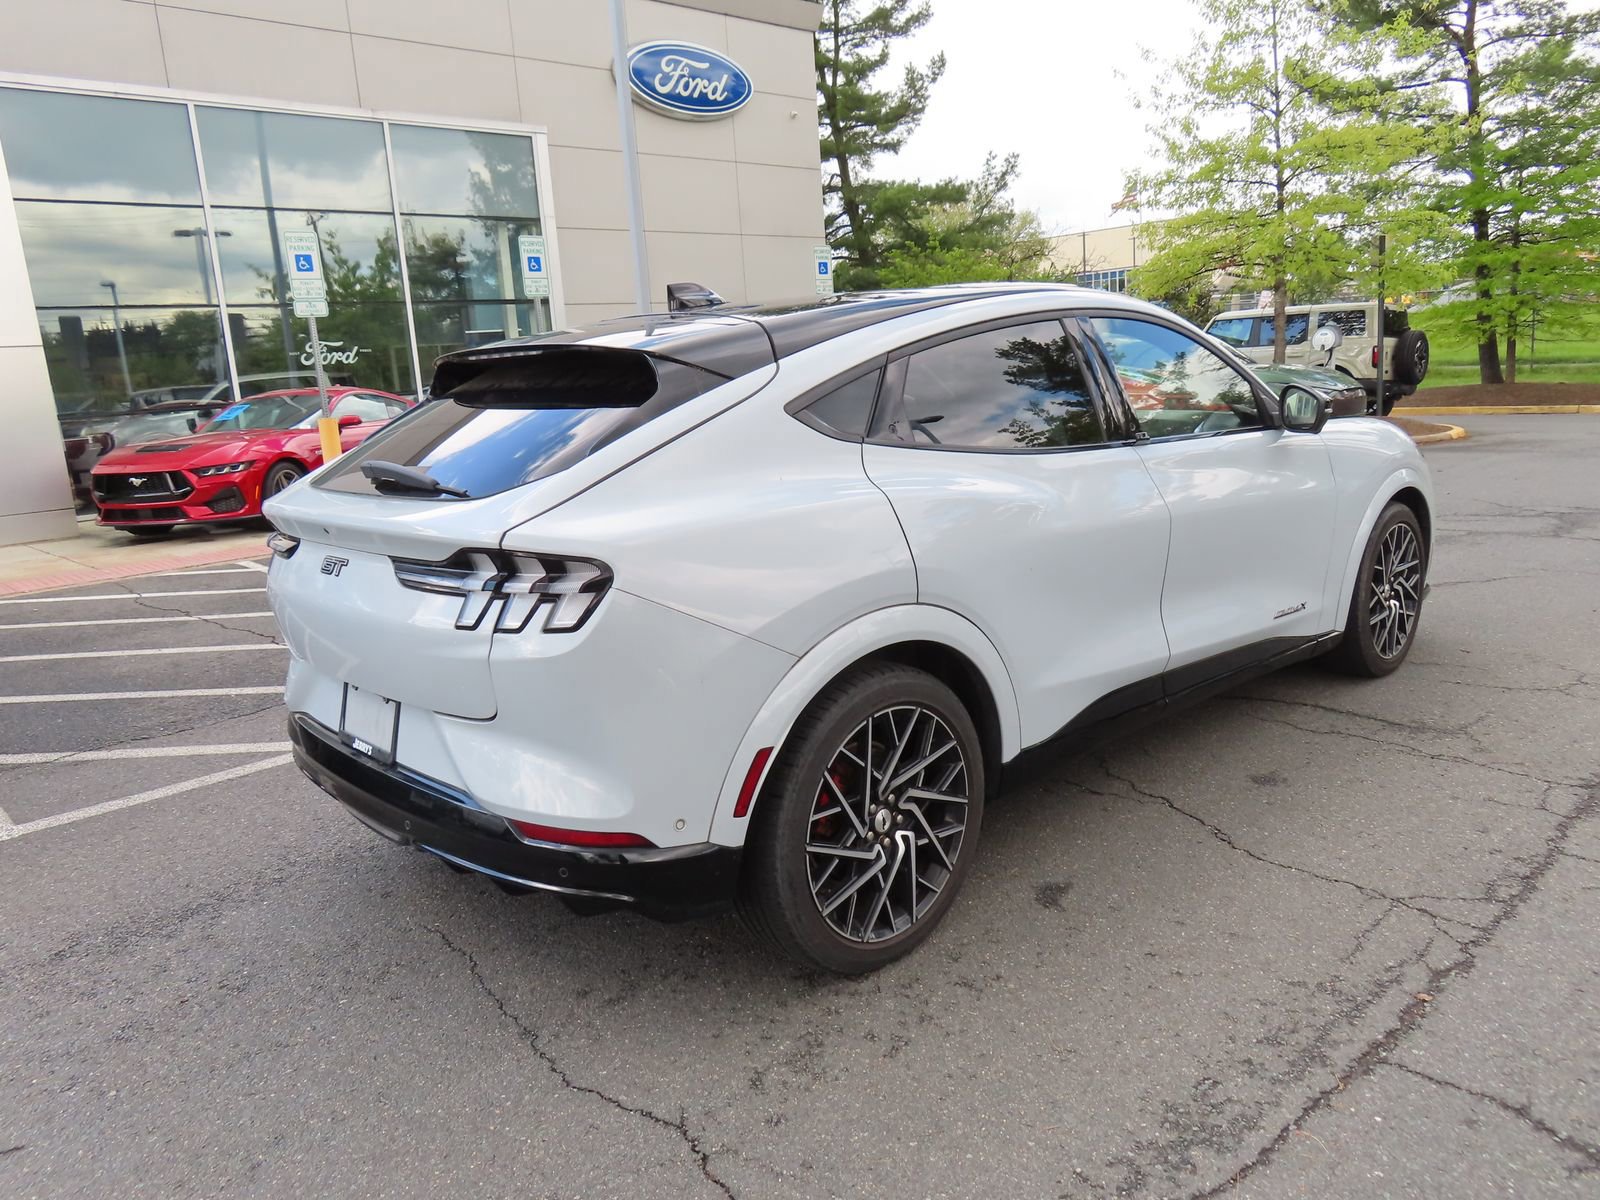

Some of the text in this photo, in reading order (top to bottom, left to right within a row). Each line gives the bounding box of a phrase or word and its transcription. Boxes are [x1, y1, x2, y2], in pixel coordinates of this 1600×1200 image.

[654, 55, 728, 101] Ford
[289, 244, 316, 252] PARKING
[301, 341, 359, 365] Ford
[320, 555, 349, 577] GT
